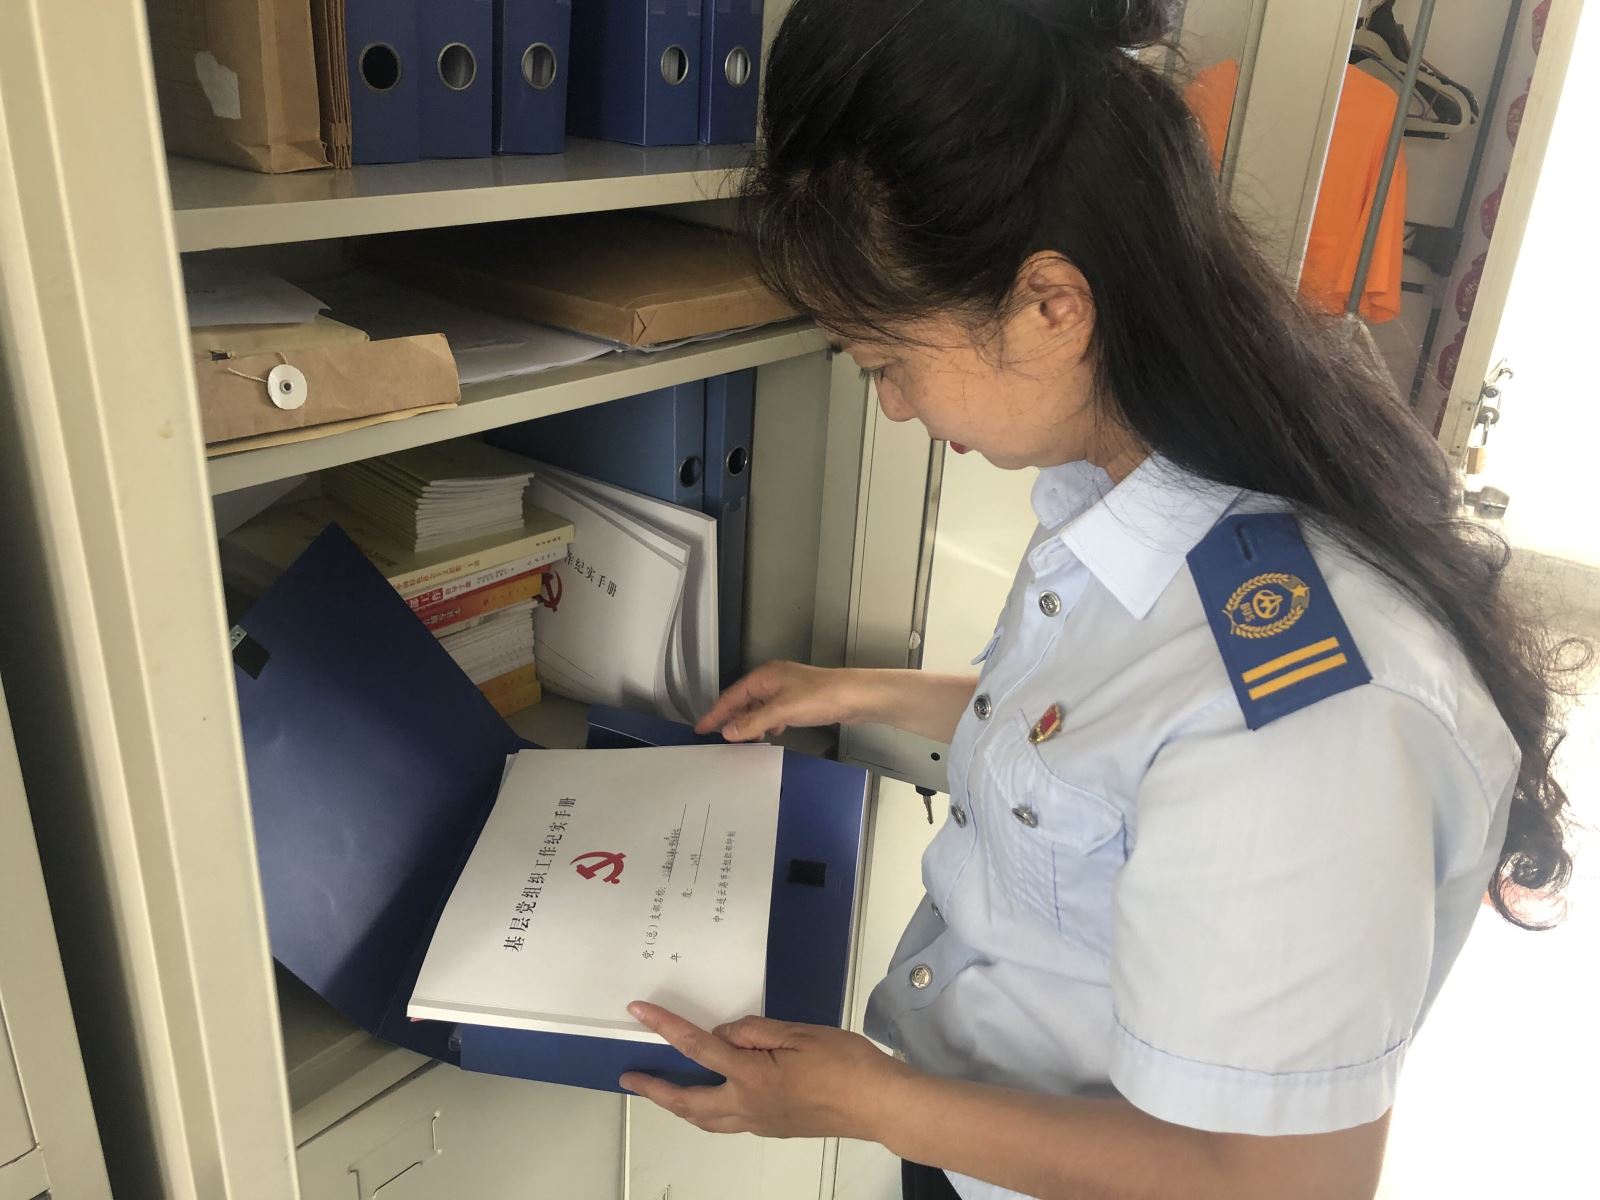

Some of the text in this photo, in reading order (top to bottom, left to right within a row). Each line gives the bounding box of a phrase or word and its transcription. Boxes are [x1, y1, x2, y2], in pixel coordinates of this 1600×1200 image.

[503, 797, 577, 952] 基层党组织工作纪实手册
